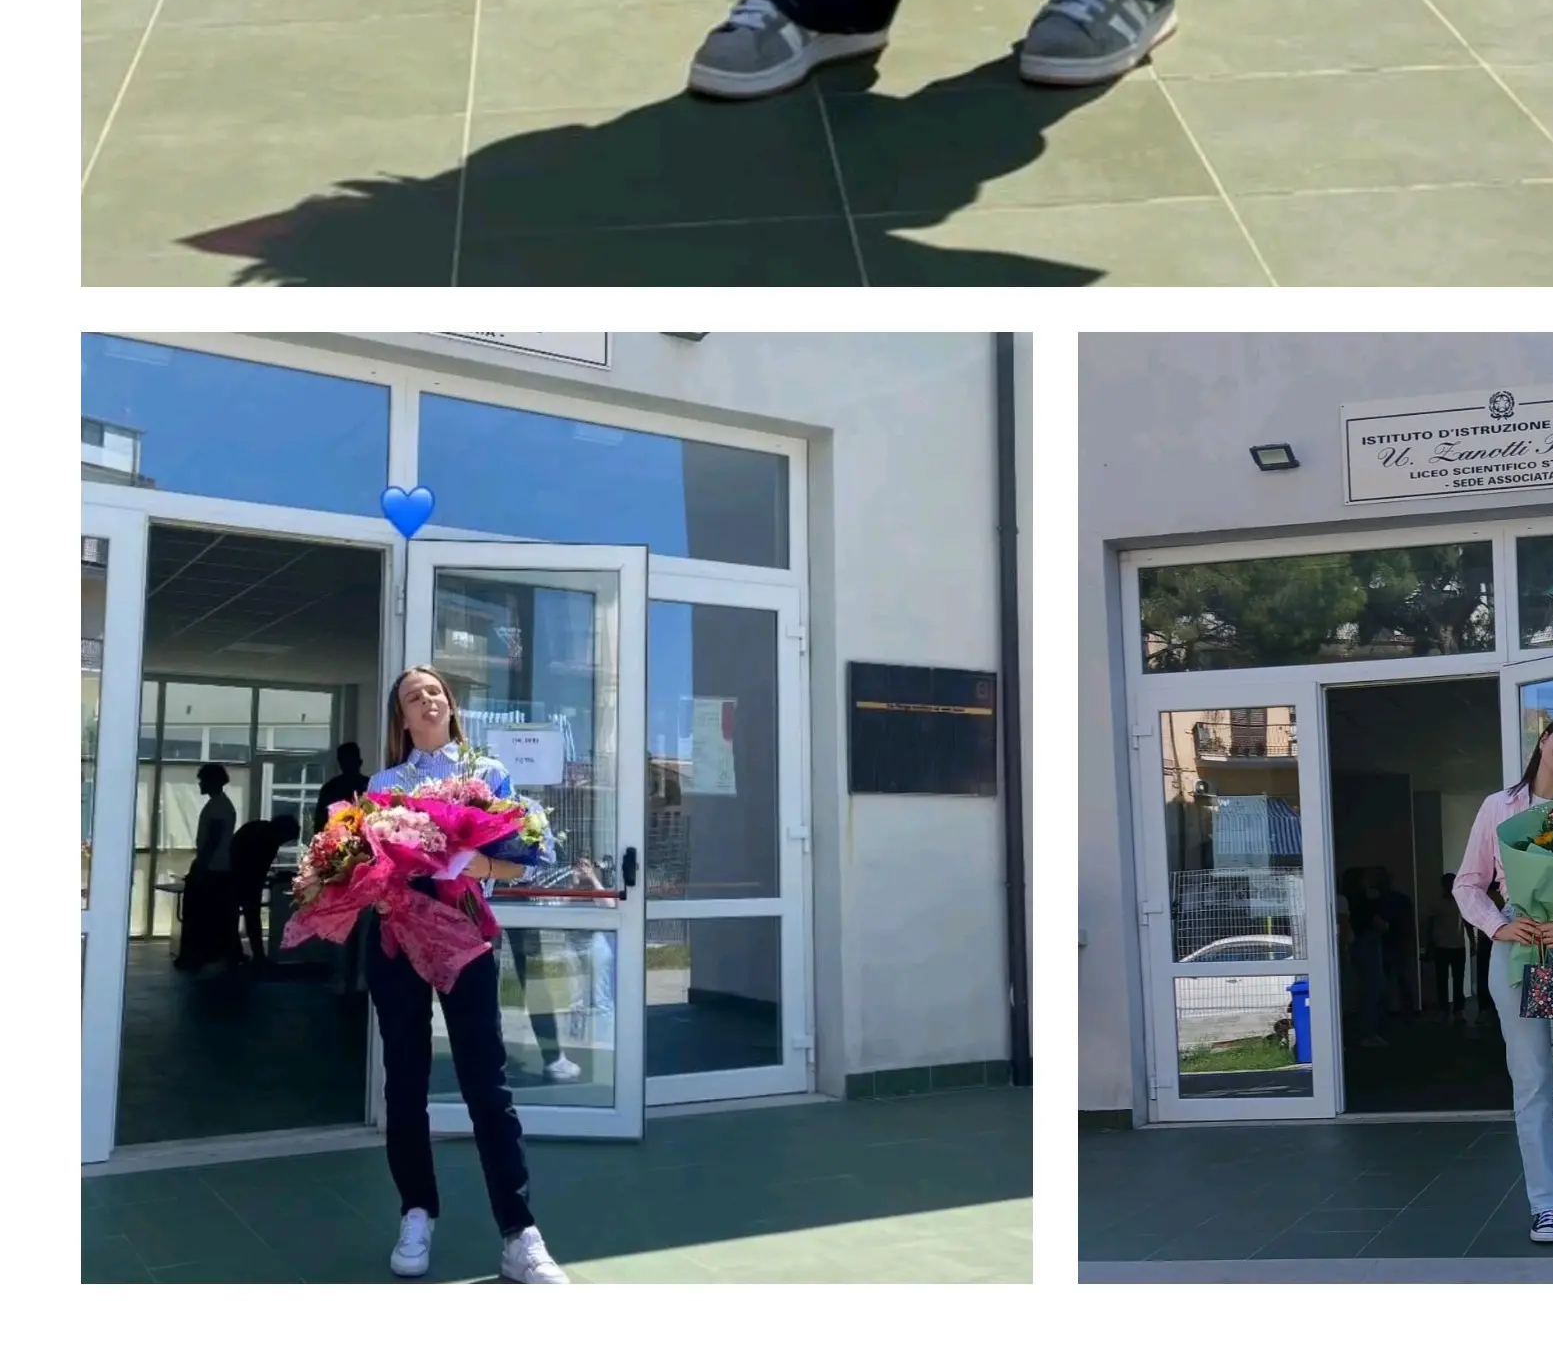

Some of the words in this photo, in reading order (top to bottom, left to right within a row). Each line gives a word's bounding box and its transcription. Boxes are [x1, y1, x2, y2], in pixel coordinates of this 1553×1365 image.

[1362, 431, 1433, 445] ISTITUTO
[1438, 420, 1552, 440] D'ISTRUZIONE
[1377, 447, 1414, 469] U.
[1429, 440, 1533, 464] Zanotti
[1410, 469, 1448, 479] LICEO
[1453, 462, 1537, 476] SCIENTIFICO
[1453, 477, 1484, 488] SEDE
